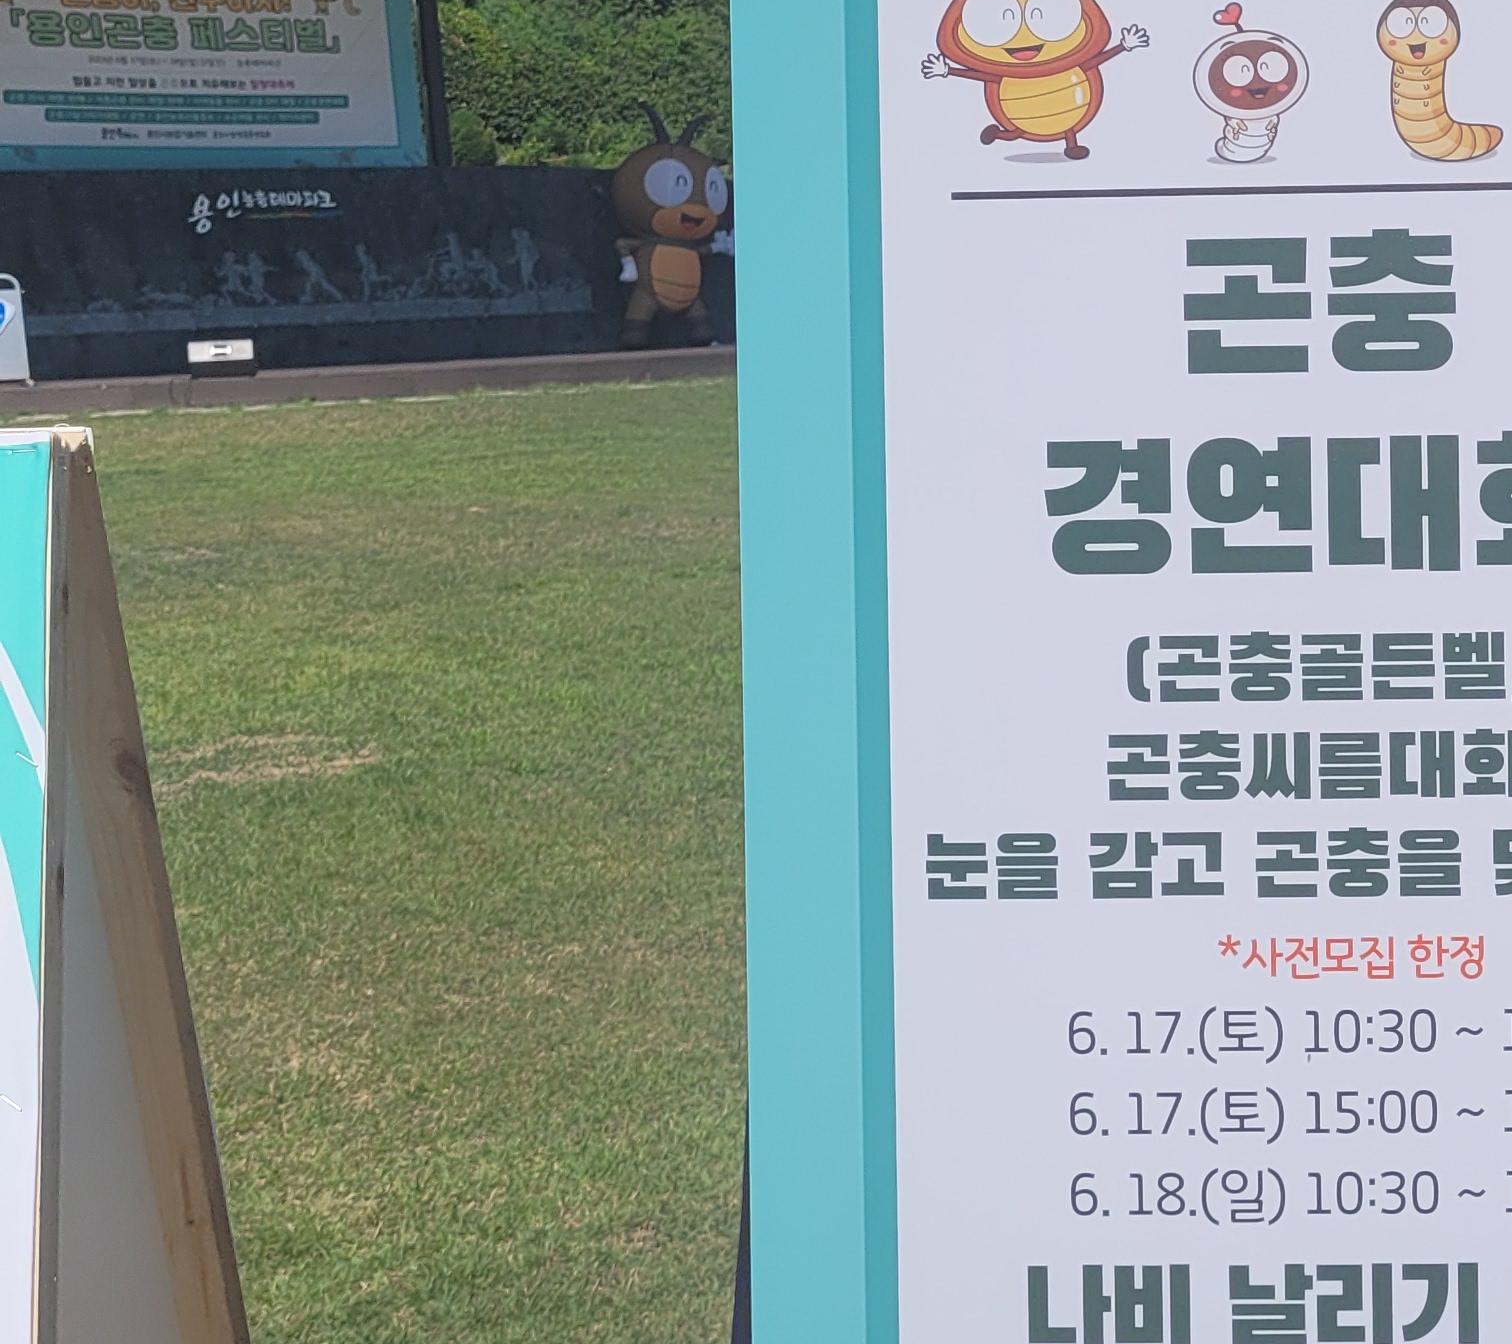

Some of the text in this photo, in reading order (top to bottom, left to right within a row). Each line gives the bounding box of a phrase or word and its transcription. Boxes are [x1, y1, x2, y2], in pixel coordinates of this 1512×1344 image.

[1183, 228, 1457, 375] 곤충
[925, 832, 1059, 900] 눈을
[1088, 831, 1225, 900] 감고
[1255, 826, 1462, 899] 곤충을
[1407, 933, 1485, 980] 한정
[1068, 1010, 1108, 1056] 6.
[1126, 1005, 1284, 1065] 17.(토)
[1304, 1008, 1437, 1054] 10:30
[1069, 1091, 1109, 1137] 6.
[1127, 1086, 1285, 1145] 17.(토)
[1305, 1089, 1438, 1135] 15:00
[1070, 1172, 1110, 1217] 6.
[1128, 1167, 1286, 1226] 18.(일)
[1306, 1170, 1440, 1215] 10:30
